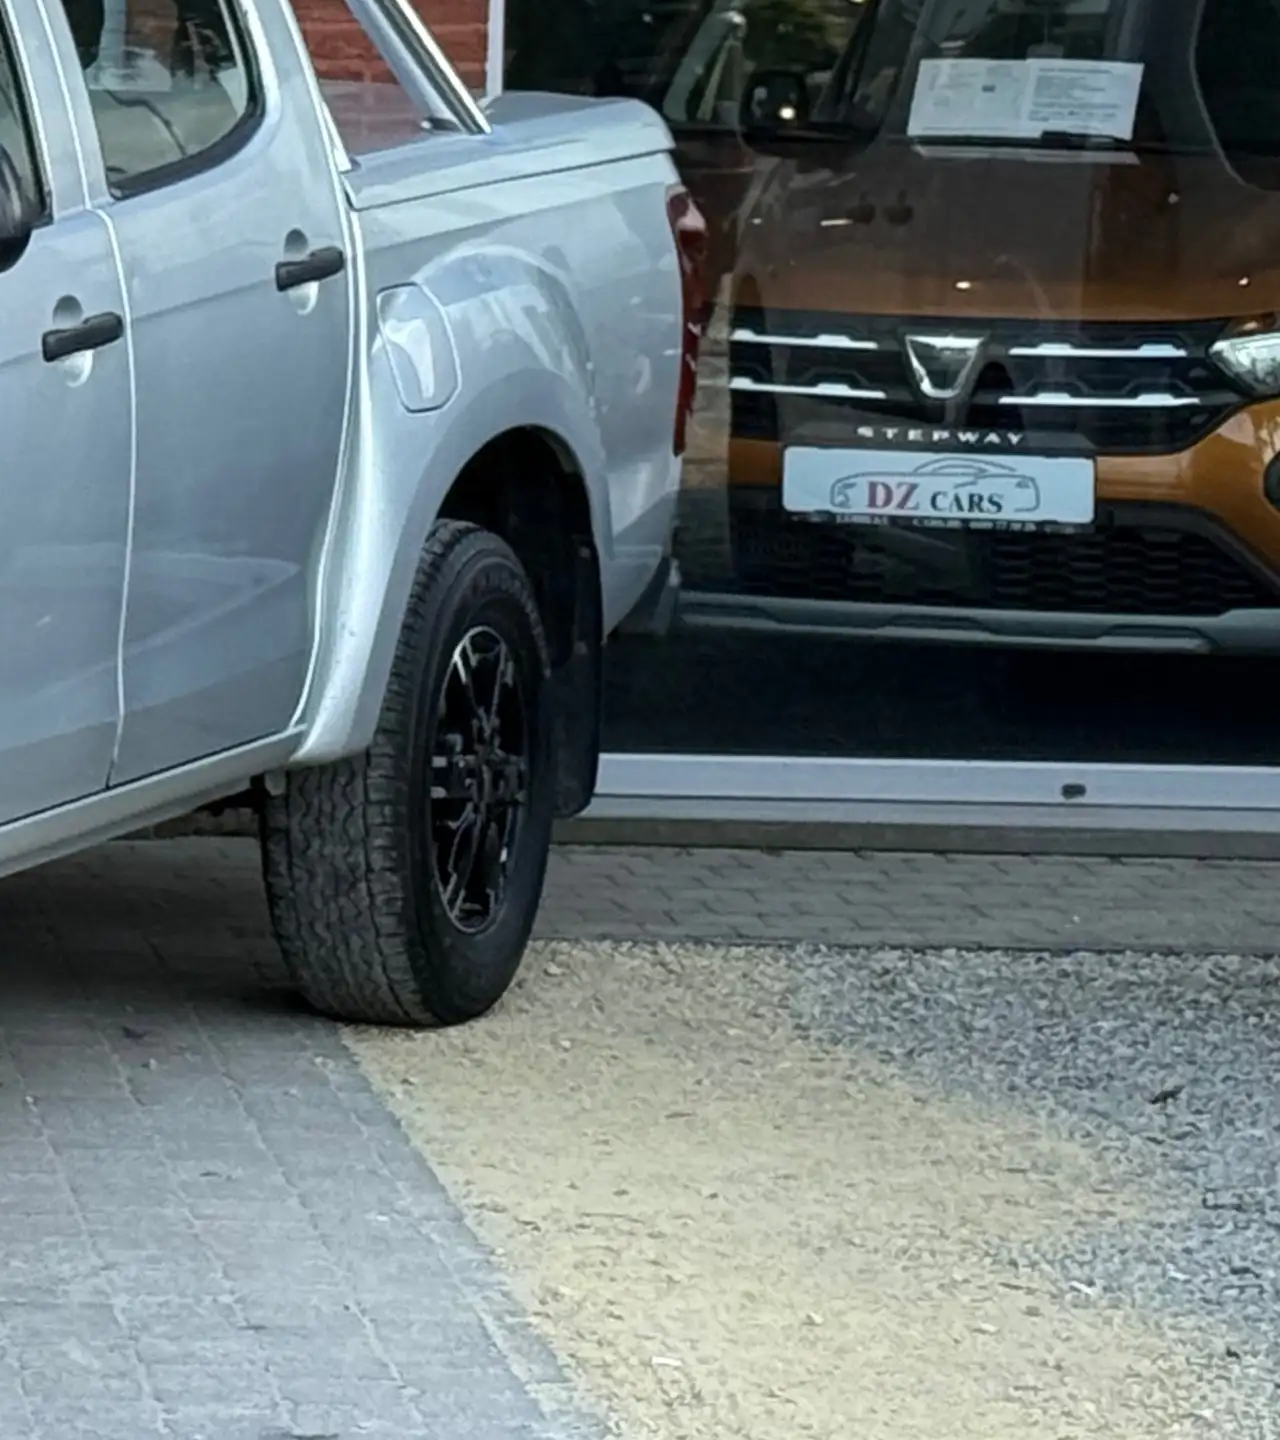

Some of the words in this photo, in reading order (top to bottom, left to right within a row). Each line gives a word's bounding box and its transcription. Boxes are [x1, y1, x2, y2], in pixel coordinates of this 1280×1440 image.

[855, 425, 1025, 446] STEPWAY
[866, 479, 921, 512] DZ
[929, 491, 1005, 514] CARS
